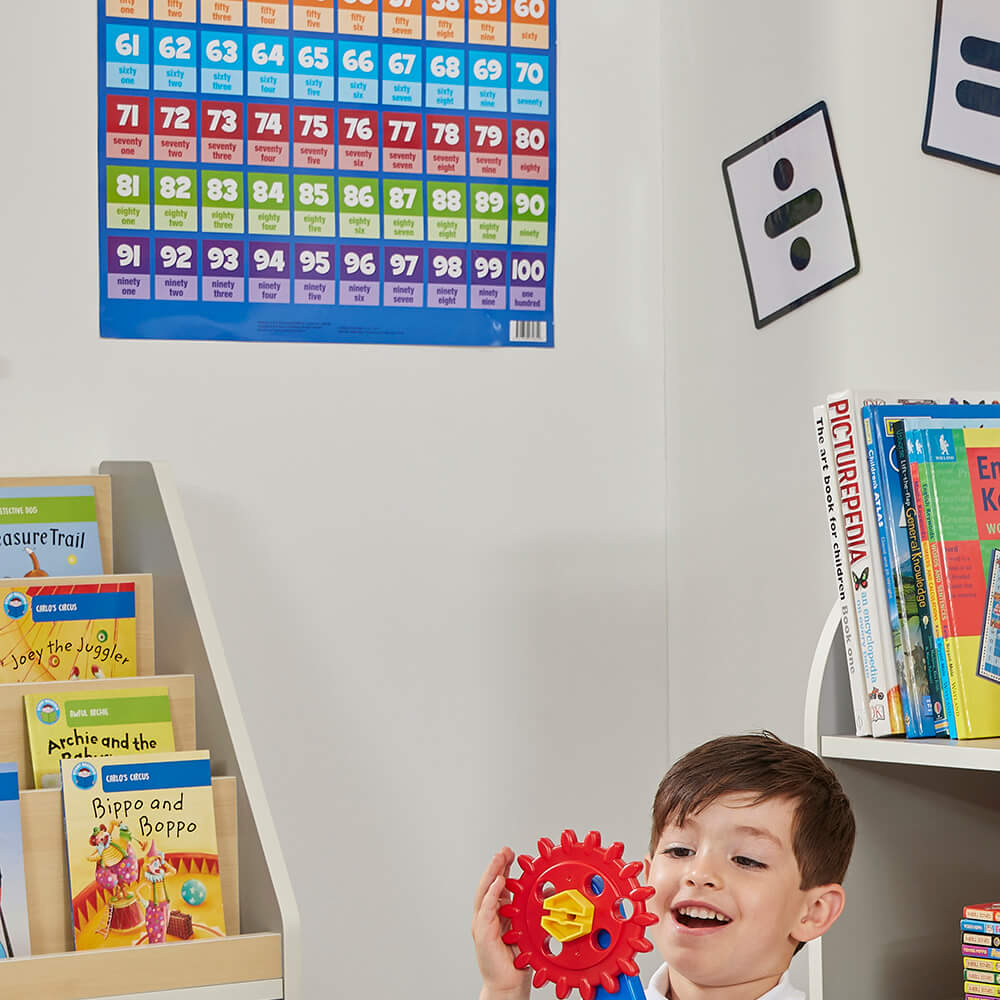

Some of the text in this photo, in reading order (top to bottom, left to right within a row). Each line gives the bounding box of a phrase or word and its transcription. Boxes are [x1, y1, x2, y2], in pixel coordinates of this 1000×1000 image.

[514, 0, 545, 18] 60
[115, 33, 139, 56] 61
[159, 36, 191, 59] 62
[206, 40, 238, 63] 63
[252, 43, 284, 66] 64
[298, 46, 329, 70] 65
[342, 49, 374, 72] 66
[388, 53, 416, 74] 67
[430, 56, 460, 78] 68
[118, 67, 136, 78] sixty
[166, 69, 184, 80] sixty
[474, 59, 502, 80] 69
[516, 62, 543, 84] 70
[120, 77, 135, 85] one
[168, 79, 183, 88] two
[117, 104, 138, 126] 71
[160, 106, 190, 130] 72
[208, 110, 237, 132] 73
[254, 112, 282, 135] 74
[300, 115, 328, 138] 75
[344, 118, 372, 140] 76
[388, 120, 416, 142] 77
[432, 123, 460, 145] 78
[474, 126, 502, 147] 79
[113, 137, 142, 148] seventy
[161, 139, 190, 150] seventy
[516, 128, 545, 150] 80
[120, 147, 135, 156] one
[168, 149, 183, 158] two
[116, 174, 139, 196] 81
[208, 178, 238, 202] 83
[300, 183, 329, 206] 85
[389, 187, 416, 209] 87
[475, 191, 504, 213] 89
[116, 207, 140, 218] eighty
[122, 217, 136, 225] one
[117, 244, 140, 266] 91
[160, 246, 192, 268] 92
[208, 247, 239, 271] 93
[254, 249, 285, 272] 94
[300, 251, 330, 274] 95
[344, 252, 376, 275] 96
[390, 254, 418, 276] 97
[433, 256, 462, 278] 98
[475, 257, 502, 279] 99
[512, 259, 544, 282] 100
[117, 278, 140, 288] ninety
[122, 288, 136, 296] one
[165, 279, 188, 290] ninety
[169, 288, 184, 297] two
[515, 298, 540, 307] hundred
[828, 399, 867, 564] PICTUREPEDIA
[874, 492, 884, 528] ATLAS
[50, 528, 86, 548] Trail
[816, 416, 824, 444] The
[820, 450, 828, 470] art
[824, 476, 834, 512] book
[834, 543, 846, 600] children
[842, 606, 851, 644] Book
[906, 507, 917, 552] General
[912, 552, 926, 608] Knowledge
[58, 602, 78, 612] CIRCUS
[12, 637, 130, 670] Joey the Juggler
[864, 608, 878, 684] encyclopedia
[48, 729, 98, 754] Archie
[102, 733, 129, 750] and
[132, 733, 157, 751] the
[106, 773, 150, 782] CARLO'S CIRCUS
[92, 792, 184, 820] Bippo and
[139, 816, 197, 838] Boppo
